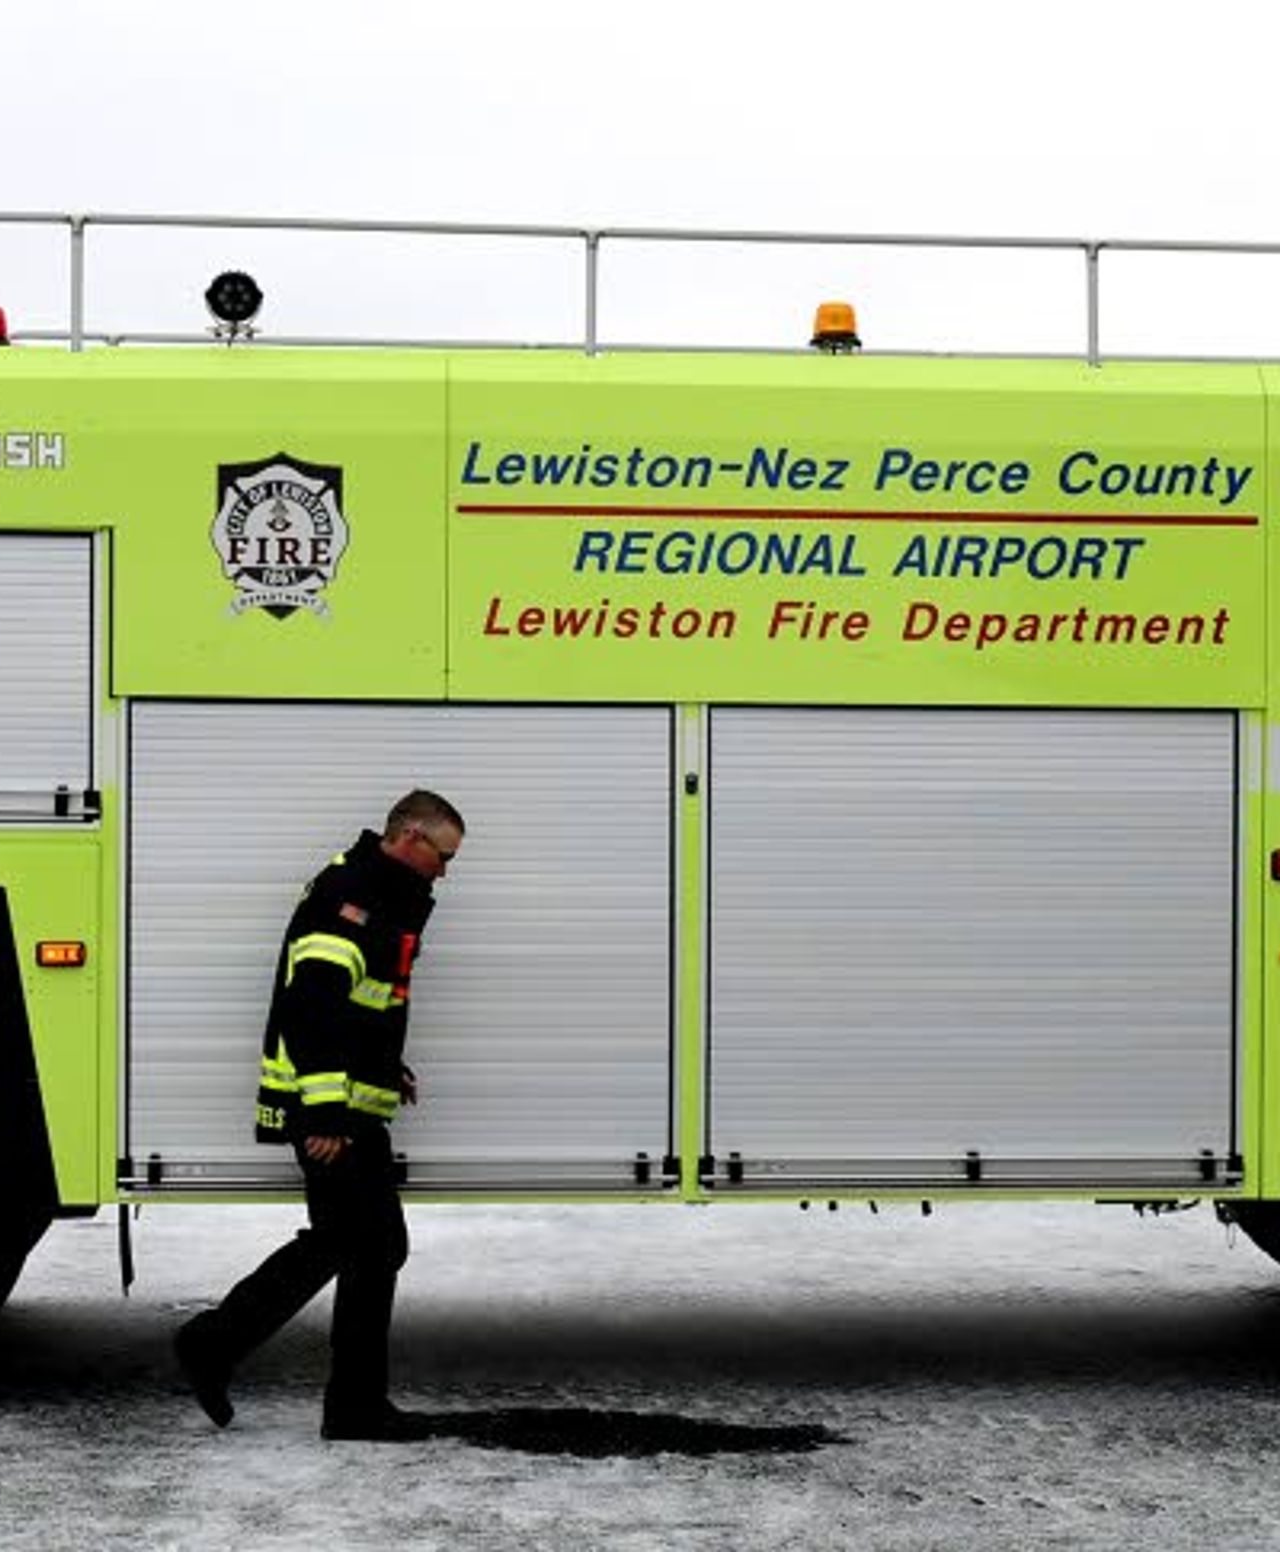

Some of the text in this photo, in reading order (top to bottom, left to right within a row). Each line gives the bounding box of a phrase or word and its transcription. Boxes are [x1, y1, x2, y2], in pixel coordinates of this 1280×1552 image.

[461, 443, 1254, 505] Lewiston-Nez Perce County
[227, 537, 332, 566] FIRE
[574, 531, 1145, 580] REGIONAL AIRPORT
[483, 597, 1231, 651] Lewiston Fire Department
